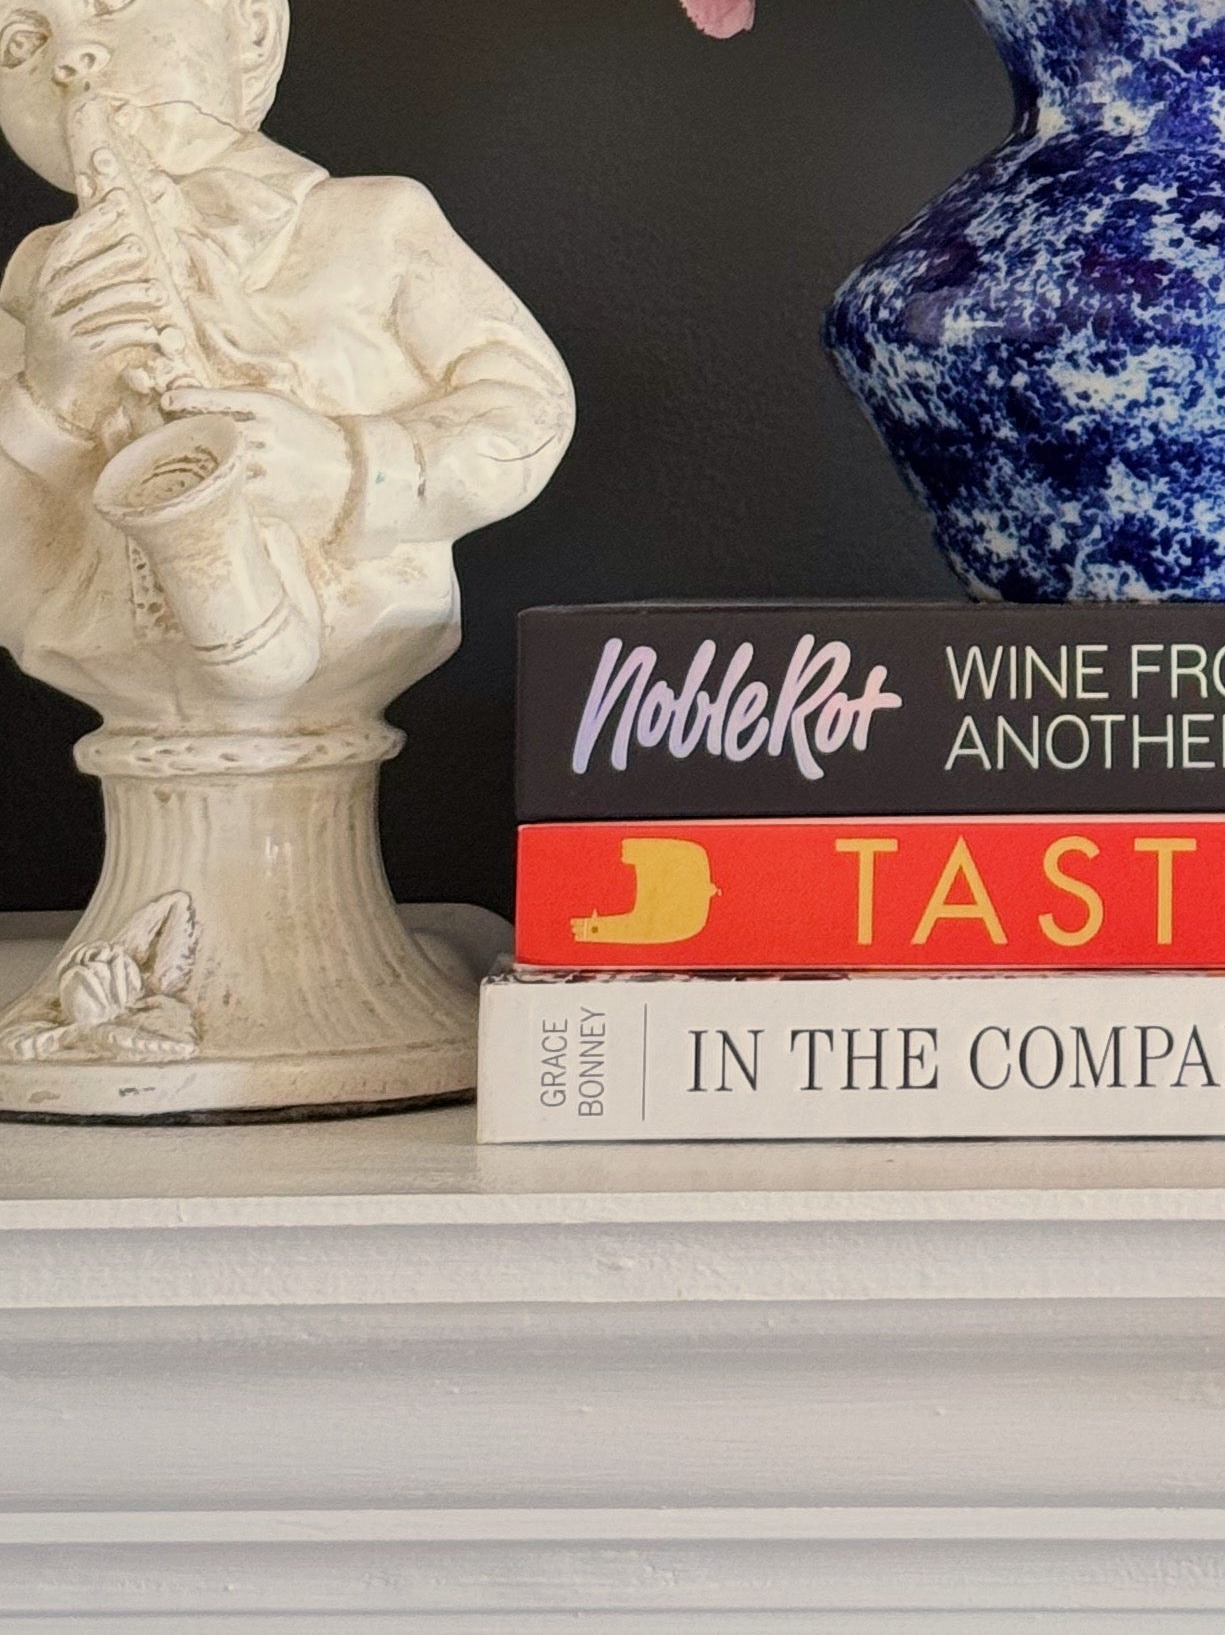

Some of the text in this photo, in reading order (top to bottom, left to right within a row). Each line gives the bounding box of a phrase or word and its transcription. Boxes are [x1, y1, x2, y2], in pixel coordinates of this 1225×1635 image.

[945, 644, 1109, 700] WINE
[540, 1019, 568, 1108] GRACE
[578, 1006, 606, 1116] BONNEY
[688, 1028, 764, 1092] IN
[790, 1027, 938, 1091] THE
